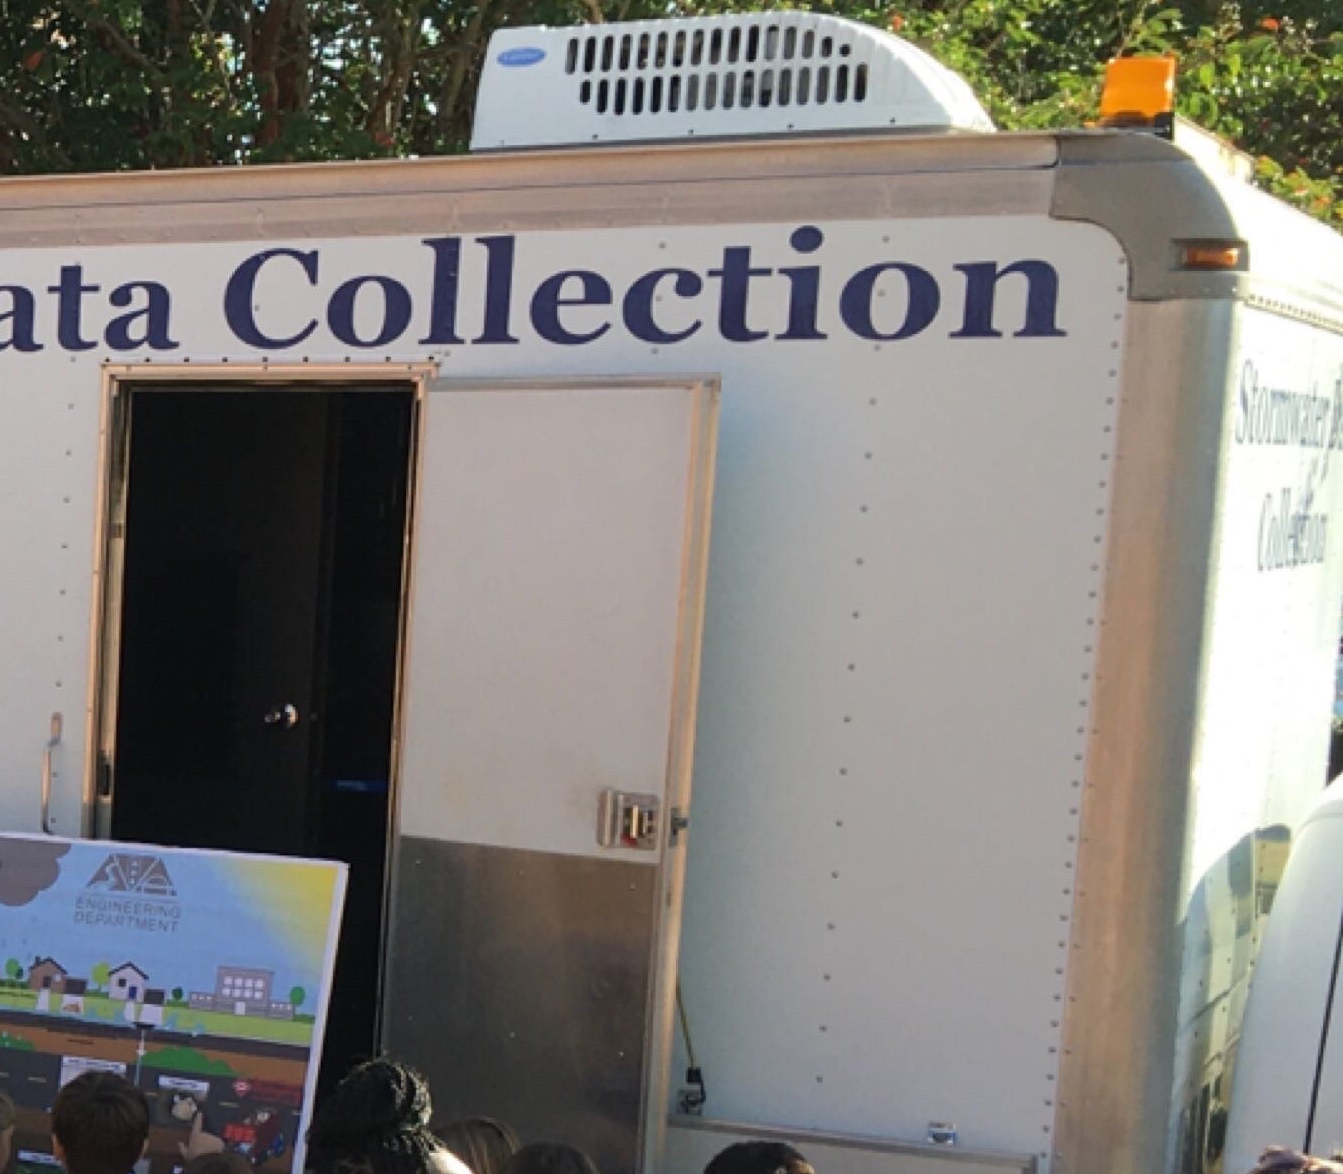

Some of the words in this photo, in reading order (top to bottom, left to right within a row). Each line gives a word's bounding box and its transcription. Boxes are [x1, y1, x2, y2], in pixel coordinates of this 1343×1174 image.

[225, 224, 1064, 350] Collection
[75, 896, 181, 920] ENGINEERING
[73, 911, 179, 932] DEPARTMENT
